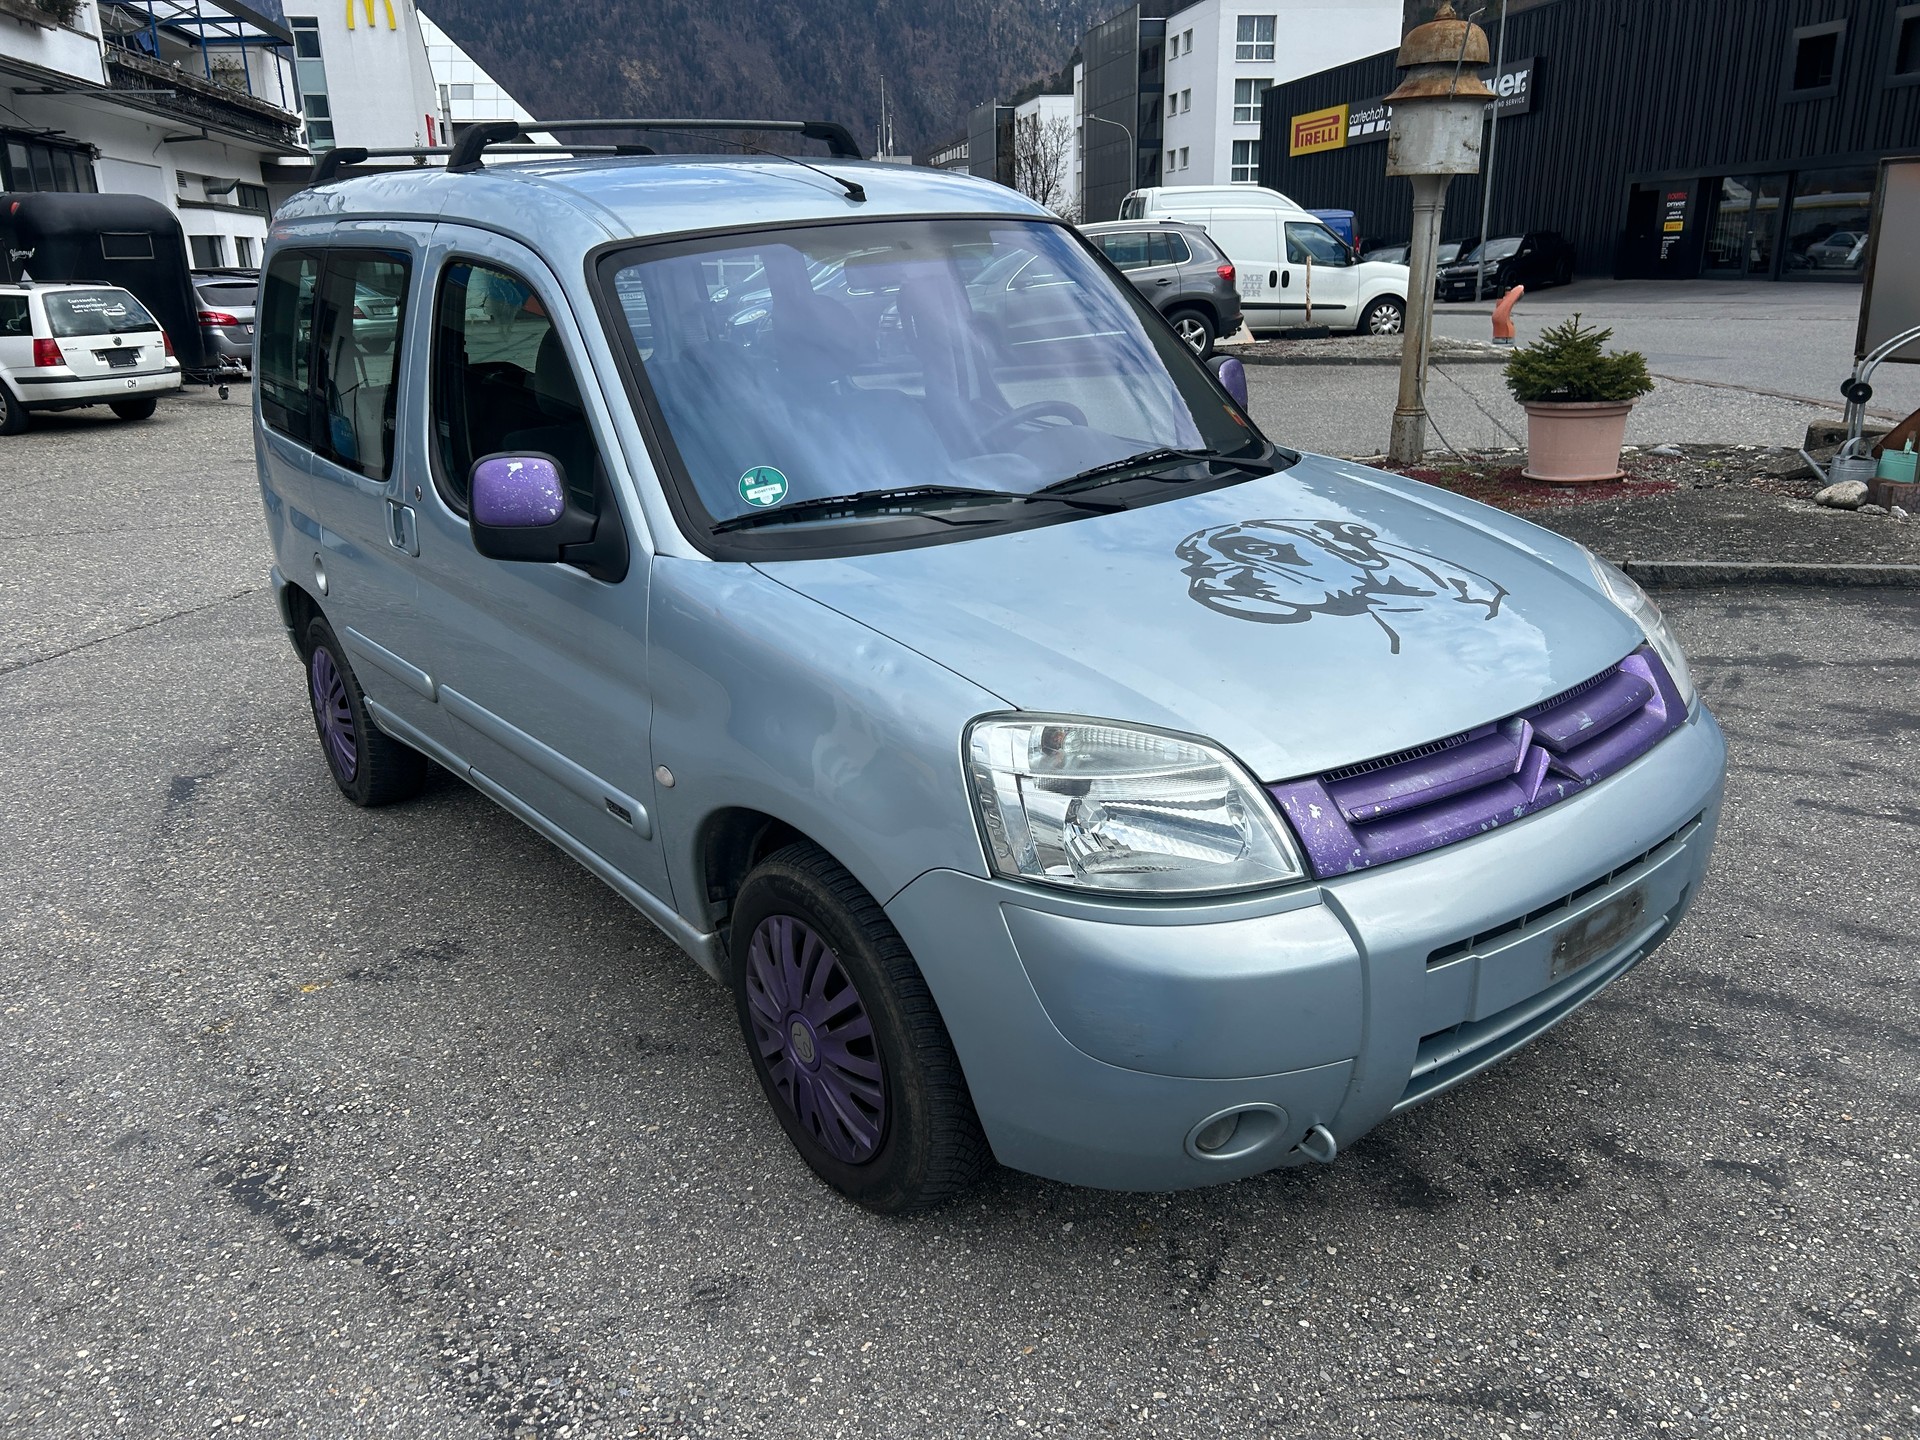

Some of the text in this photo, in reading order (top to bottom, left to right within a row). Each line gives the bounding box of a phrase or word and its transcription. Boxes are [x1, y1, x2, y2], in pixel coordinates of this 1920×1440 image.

[1482, 70, 1528, 97] ver
[1505, 96, 1525, 106] SERVICE
[1349, 105, 1384, 125] cartech.ch
[1295, 115, 1340, 148] PIRELLI
[127, 380, 137, 389] CH
[755, 470, 768, 485] 4
